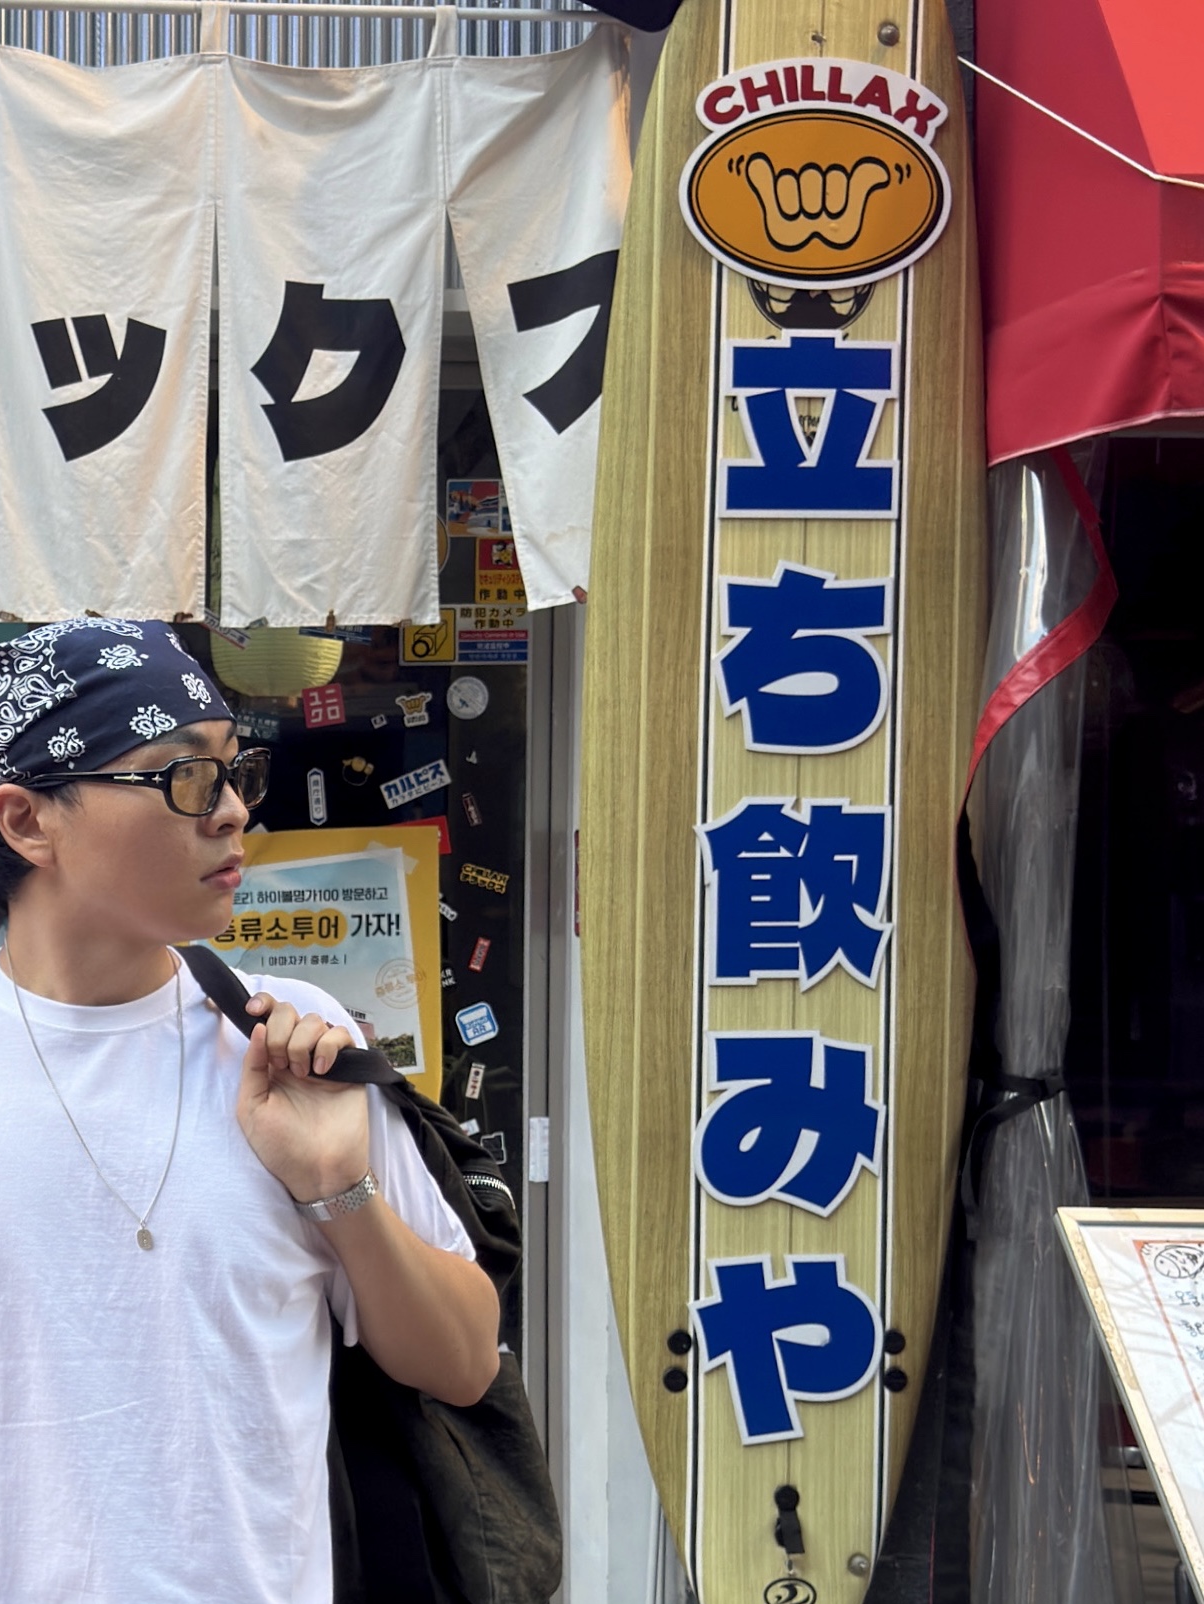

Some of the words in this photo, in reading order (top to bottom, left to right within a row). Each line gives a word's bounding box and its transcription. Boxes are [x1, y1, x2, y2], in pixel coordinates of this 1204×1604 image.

[703, 65, 940, 138] CHILLAX
[460, 607, 526, 618] 防犯カメラ
[475, 619, 514, 629] 作動中
[384, 762, 445, 799] カルピス
[342, 887, 388, 901] 방문하고
[695, 334, 895, 1440] 立ち飲みや
[350, 912, 401, 938] 가자!
